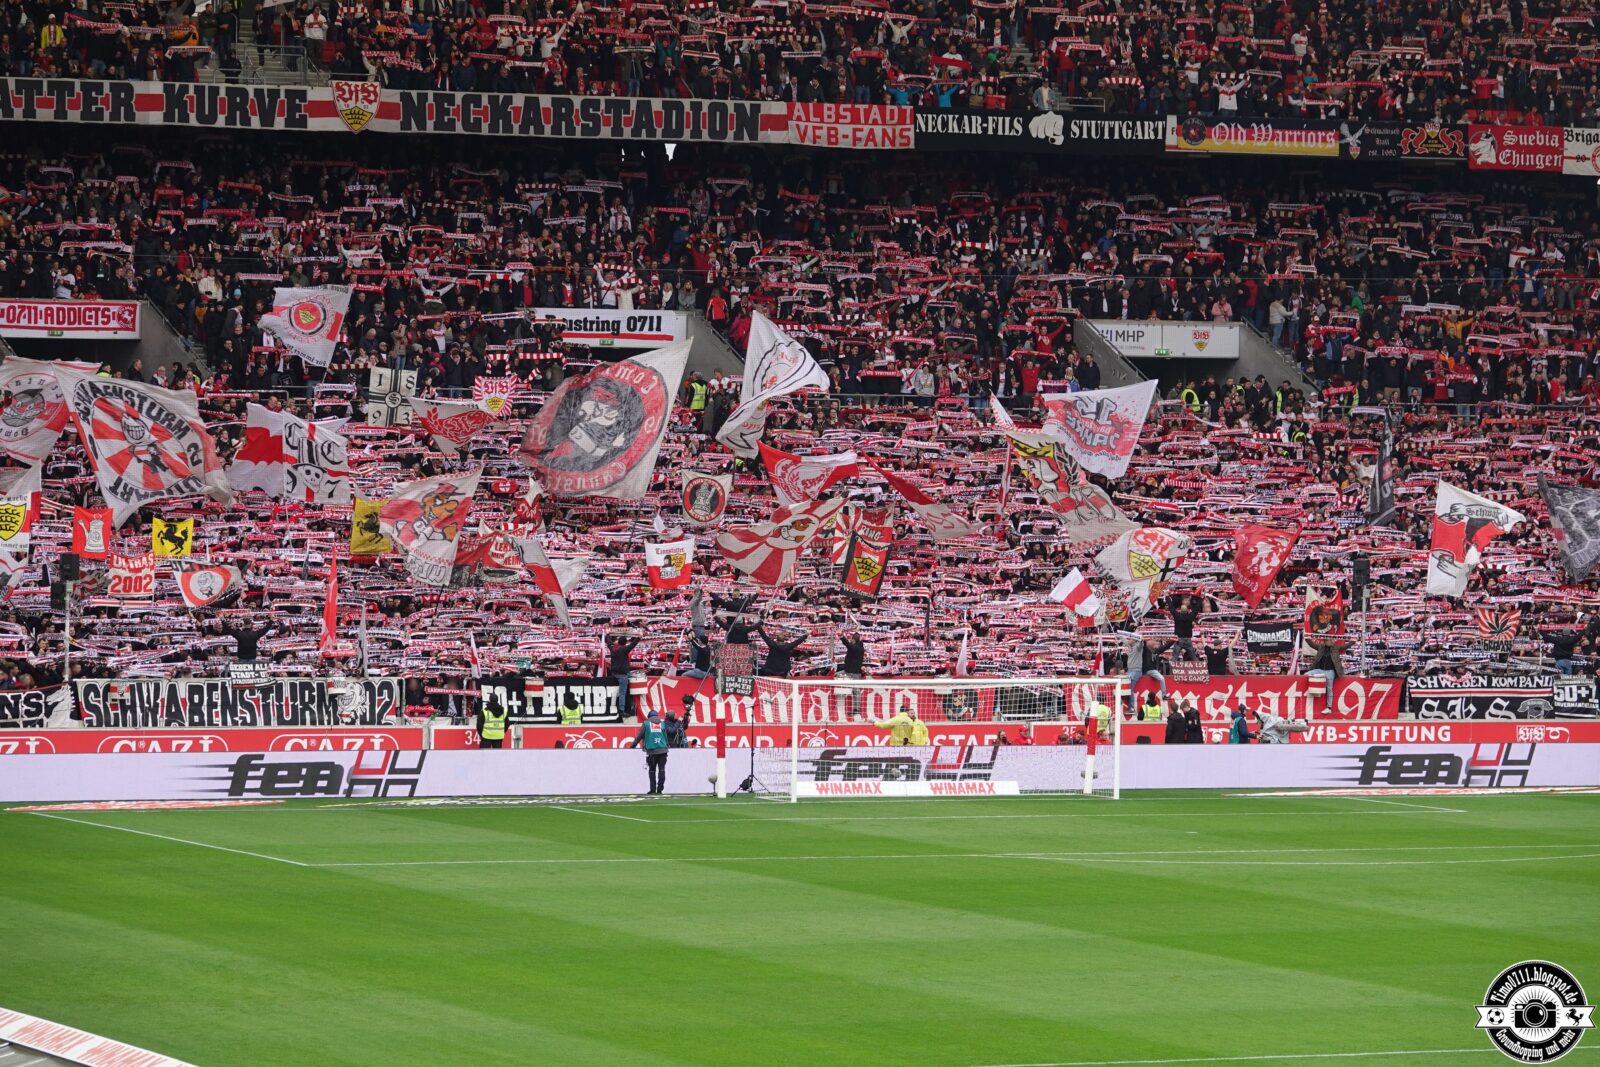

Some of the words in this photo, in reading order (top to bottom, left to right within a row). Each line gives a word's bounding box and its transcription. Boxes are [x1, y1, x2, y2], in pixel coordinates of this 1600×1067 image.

[335, 81, 379, 105] VfB
[163, 83, 308, 129] KURVE
[400, 91, 761, 141] NECKARSTADION
[792, 102, 914, 125] ALBSTADT
[795, 124, 912, 149] VFB-FANS
[915, 113, 1023, 137] NECKAR-FILS
[1070, 118, 1165, 140] STUTTGART
[1212, 121, 1247, 146] Old
[1251, 122, 1338, 149] Warriors
[1503, 130, 1560, 148] Suebia
[1500, 149, 1562, 169] Ehingen
[6, 305, 39, 325] 0711
[44, 306, 111, 326] ADDICTS
[627, 316, 662, 332] 0711
[1115, 330, 1145, 343] MHP
[110, 573, 154, 594] 2002
[1247, 628, 1292, 643] COMMANDO
[726, 682, 752, 690] IMMER
[1554, 686, 1599, 703] 50+1
[1337, 681, 1393, 721] 97
[1303, 727, 1451, 742] VfB-STIFTUNG
[816, 783, 882, 795] WINAMAX
[930, 783, 996, 795] WINAMAX
